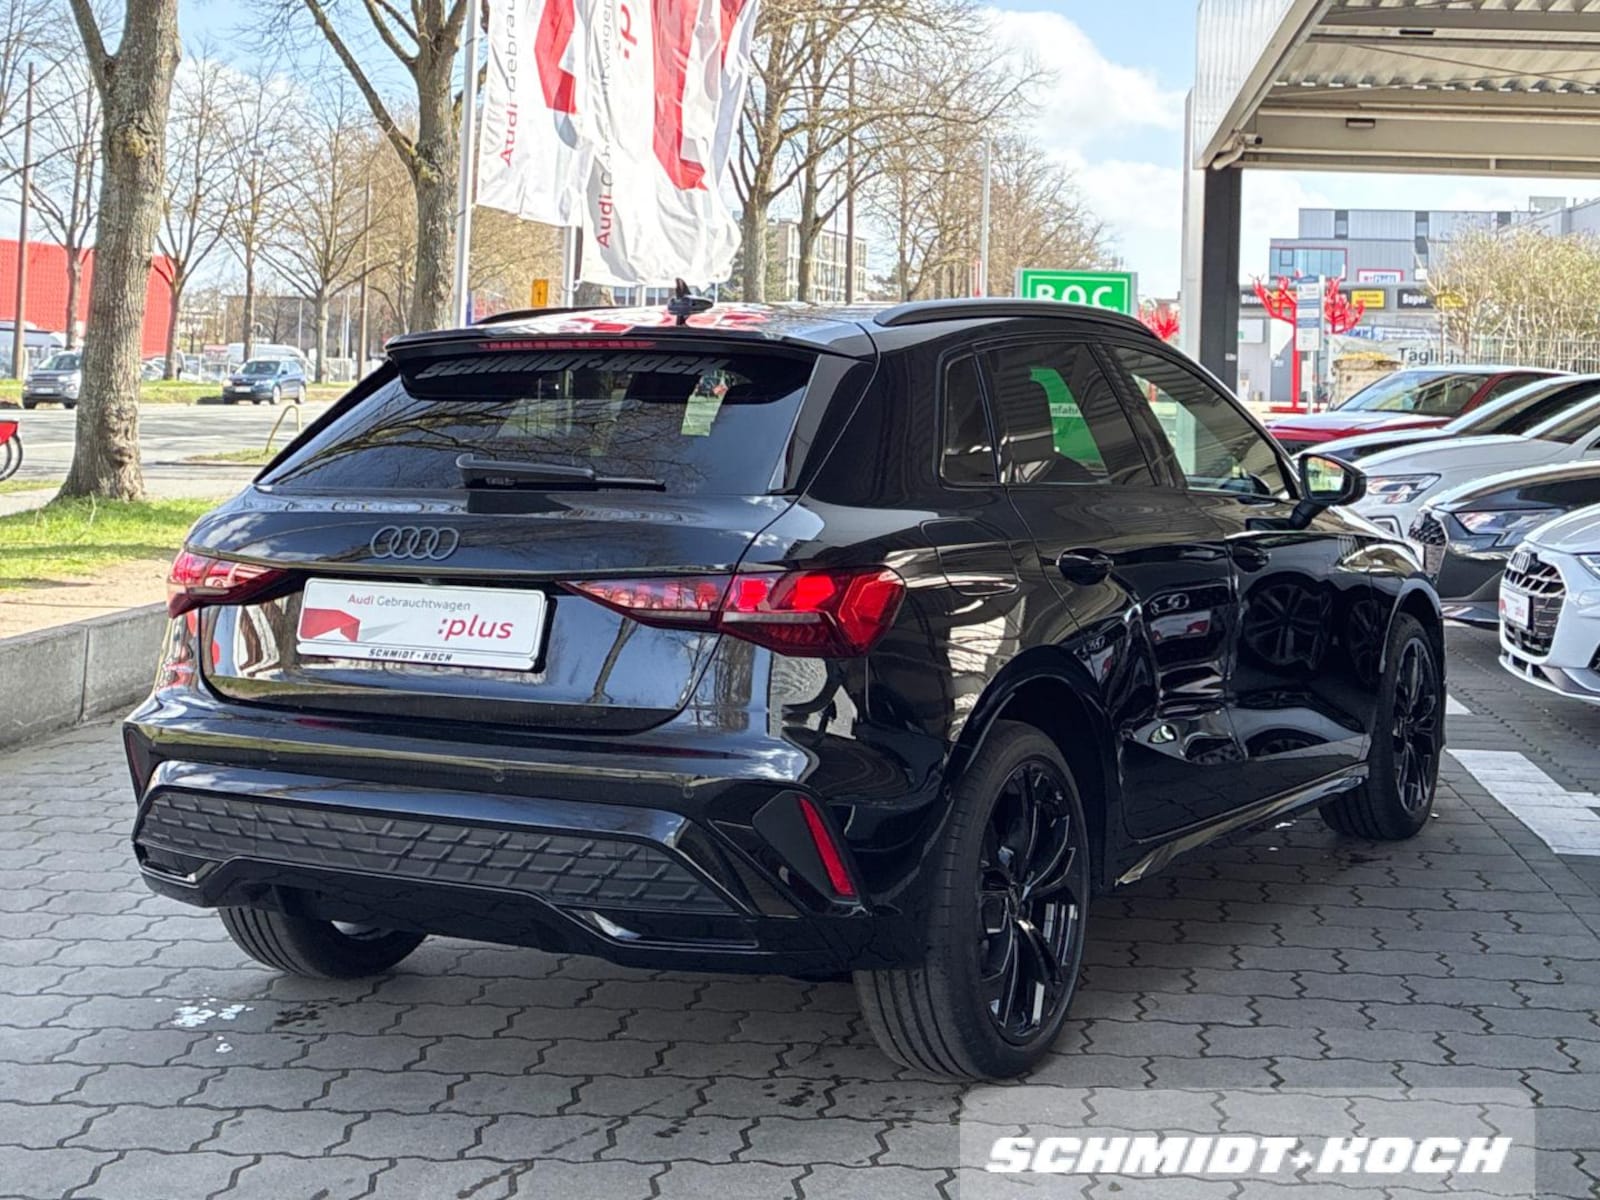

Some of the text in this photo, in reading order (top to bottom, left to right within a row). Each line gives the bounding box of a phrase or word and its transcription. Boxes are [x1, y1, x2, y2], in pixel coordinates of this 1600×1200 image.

[500, 102, 518, 168] Audi
[597, 194, 613, 248] Audi
[1036, 284, 1112, 309] BOC
[347, 593, 472, 611] Audi Gebrauchtwagen
[437, 614, 514, 641] :plus
